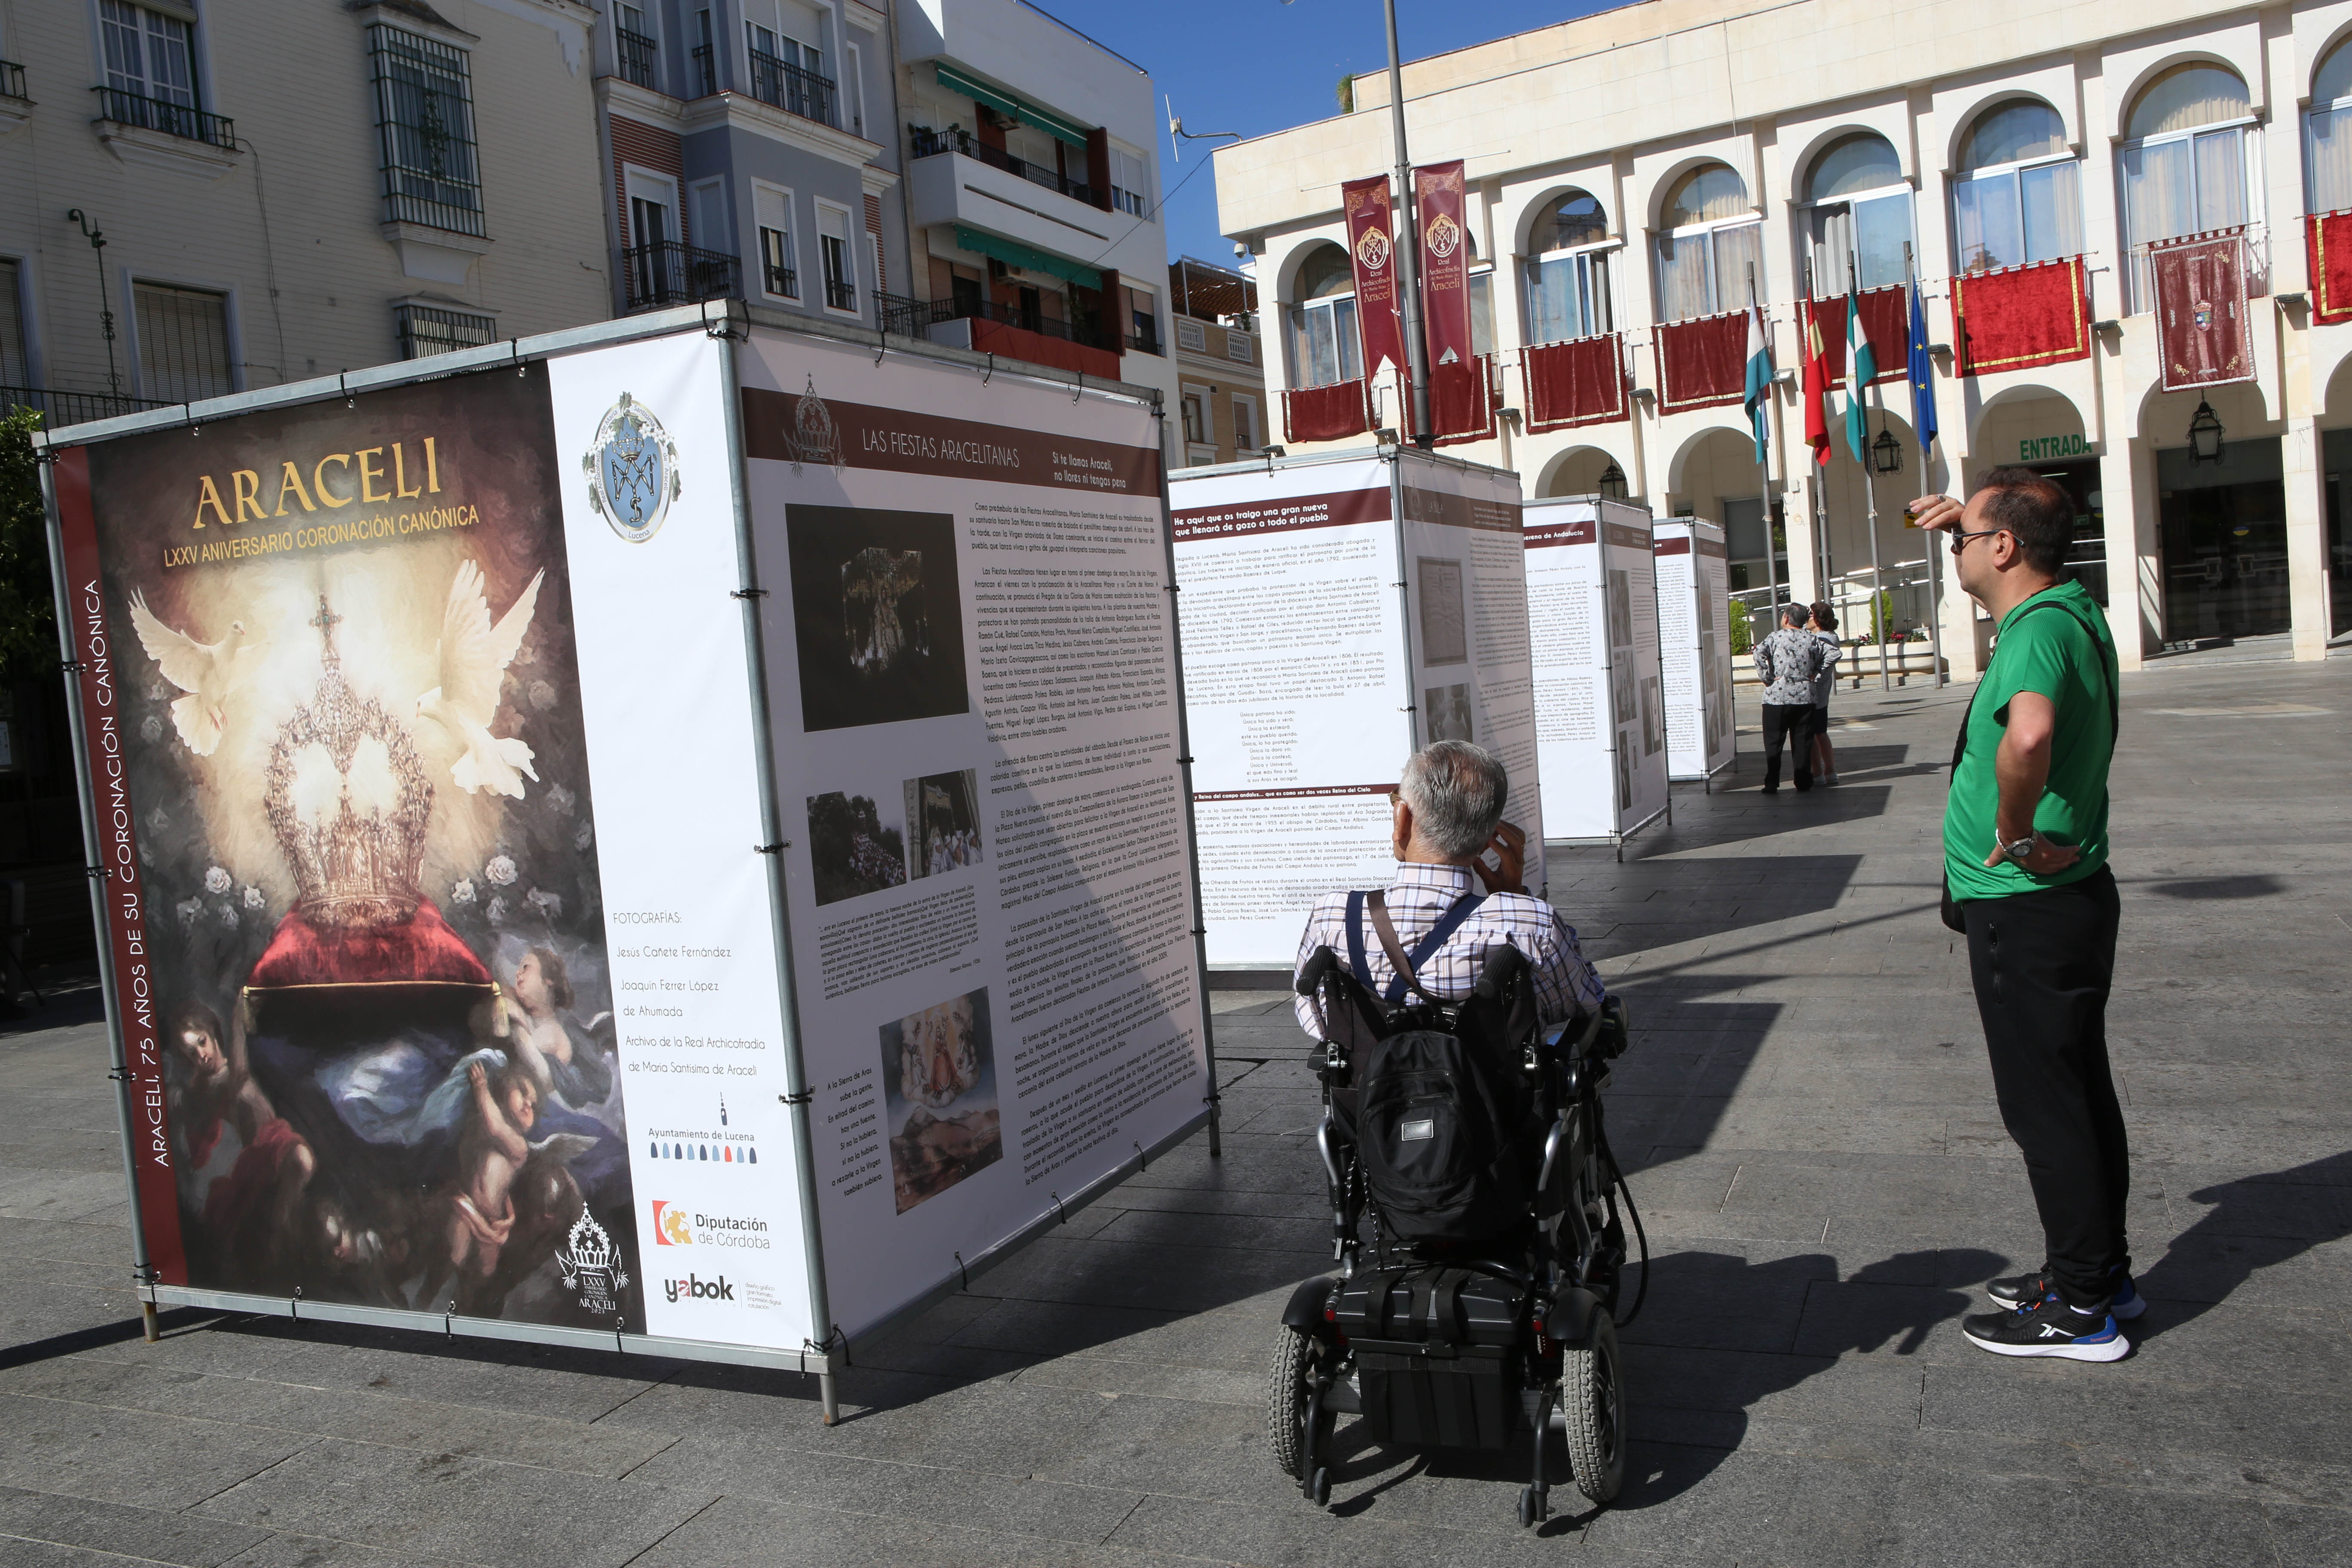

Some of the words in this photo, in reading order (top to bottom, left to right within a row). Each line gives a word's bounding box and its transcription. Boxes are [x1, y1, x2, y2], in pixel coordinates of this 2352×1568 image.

[1370, 270, 1383, 278] Real
[1430, 278, 1459, 292] Araceli
[863, 429, 886, 452] LAS
[891, 432, 936, 458] FIESTAS
[941, 439, 1019, 468] ARACELITANAS
[2020, 434, 2092, 461] ENTRADA
[1053, 451, 1059, 464] Si
[1060, 454, 1067, 465] te
[1069, 454, 1088, 468] llamas
[1090, 457, 1112, 472] Araceli,
[193, 436, 442, 530] ARACELI
[1054, 472, 1062, 481] no
[1064, 470, 1081, 483] llores
[1083, 473, 1088, 484] ni
[1090, 474, 1110, 487] tengas
[1112, 479, 1126, 488] pena
[1174, 518, 1184, 526] He
[1187, 516, 1204, 525] aquí
[1207, 515, 1222, 523] que
[1236, 511, 1261, 519] traigo
[1281, 507, 1300, 516] gran
[1303, 504, 1327, 514] nueva
[1192, 524, 1220, 534] llenará
[1223, 523, 1233, 531] de
[1236, 522, 1256, 531] gozo
[1268, 517, 1287, 526] todo
[1289, 516, 1297, 524] el
[1300, 513, 1328, 524] pueblo
[164, 544, 198, 568] LXXV
[202, 532, 293, 564] ANIVERSARIO
[297, 514, 395, 549] CORONACIÓN
[399, 504, 480, 534] CANÓNICA
[628, 530, 651, 539] Lucena
[1553, 530, 1584, 539] Andalucía
[84, 580, 112, 707] CANÓNICA
[987, 734, 1007, 742] Valdivia,
[101, 717, 135, 884] CORONACIÓN
[123, 893, 139, 921] SU
[613, 910, 682, 924] FOTOGRAFÍAS:
[128, 929, 144, 955] DE
[617, 946, 640, 957] Jesús
[643, 946, 678, 957] Cañete
[682, 946, 732, 957] Fernández
[621, 980, 656, 992] Joaquín
[660, 979, 686, 990] Ferrer
[689, 980, 719, 992] López
[132, 964, 152, 1029] AÑOS
[623, 1005, 635, 1016] de
[639, 1005, 683, 1017] Ahumada
[626, 1035, 657, 1046] Archivo
[659, 1036, 671, 1047] de
[674, 1036, 682, 1047] la
[685, 1036, 704, 1047] Real
[707, 1037, 765, 1049] Archicofradía
[142, 1038, 157, 1066] 75
[628, 1061, 640, 1072] de
[643, 1061, 668, 1072] María
[671, 1062, 709, 1074] Santísima
[713, 1063, 724, 1075] de
[727, 1064, 756, 1075] Araceli
[839, 1076, 852, 1086] Sierra
[862, 1068, 872, 1077] Aras
[840, 1093, 851, 1102] sube
[859, 1084, 873, 1095] gente.
[835, 1108, 848, 1120] mitad
[858, 1099, 875, 1109] camino
[146, 1075, 169, 1167] ARACELI,
[841, 1126, 849, 1134] hay
[851, 1121, 859, 1129] una
[860, 1114, 876, 1124] fuente.
[649, 1128, 709, 1139] Ayuntamiento
[712, 1130, 722, 1139] de
[725, 1131, 754, 1141] Lucena
[837, 1171, 854, 1184] rezarle
[866, 1159, 881, 1169] Virgen
[844, 1183, 863, 1197] también
[864, 1174, 882, 1187] subiera.
[696, 1214, 767, 1231] Diputación
[698, 1231, 713, 1244] de
[717, 1232, 770, 1249] Córdoba
[583, 1276, 605, 1286] LXXV
[665, 1273, 734, 1303] yabok
[579, 1298, 616, 1310] ARACELI
